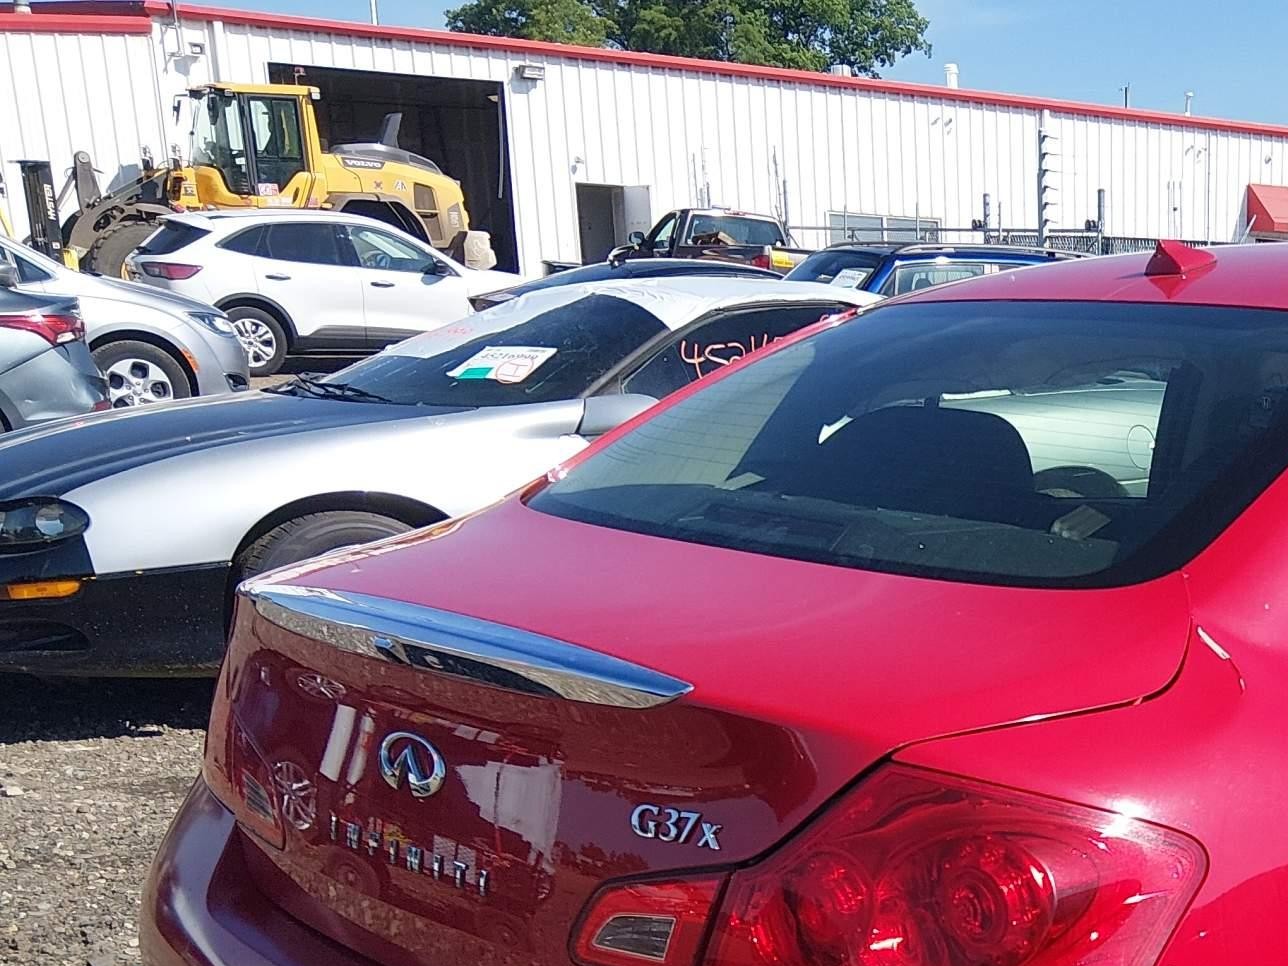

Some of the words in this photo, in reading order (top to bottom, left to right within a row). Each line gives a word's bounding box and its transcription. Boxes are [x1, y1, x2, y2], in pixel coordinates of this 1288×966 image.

[345, 159, 382, 168] VOLVO
[43, 184, 57, 221] HYSTER
[630, 803, 722, 851] G37x
[330, 814, 489, 897] INFINITI
